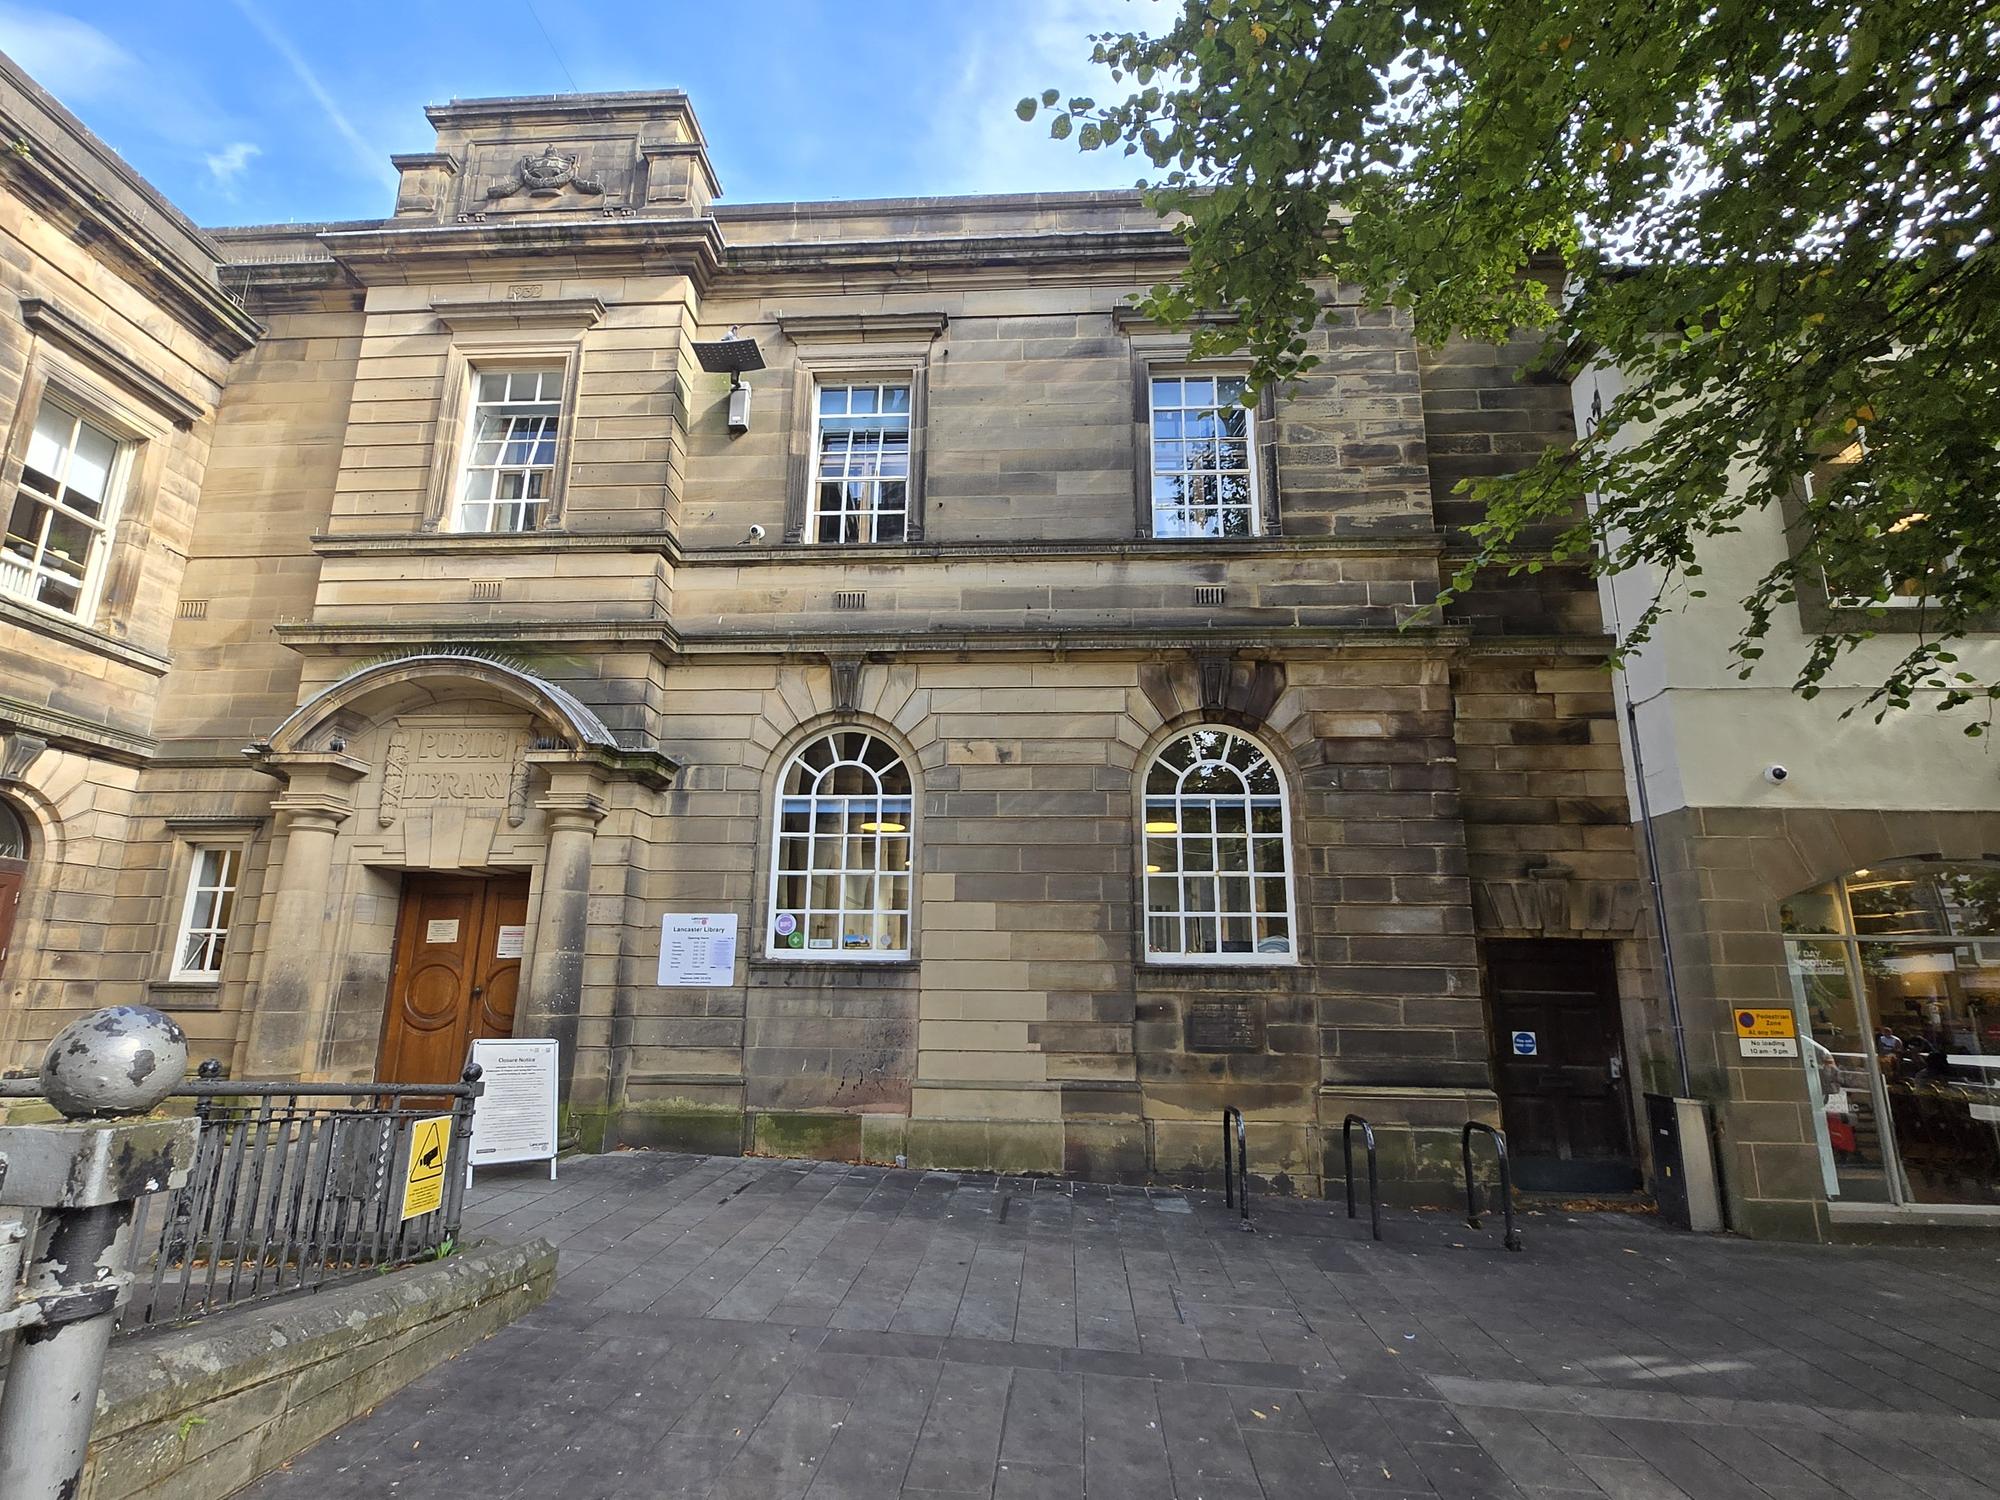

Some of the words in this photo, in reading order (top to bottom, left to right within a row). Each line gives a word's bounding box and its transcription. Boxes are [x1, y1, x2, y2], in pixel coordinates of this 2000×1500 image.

[419, 732, 506, 758] PUBLIC
[402, 772, 511, 800] LIBRARY
[703, 926, 725, 934] Library
[1803, 950, 1820, 958] DAY
